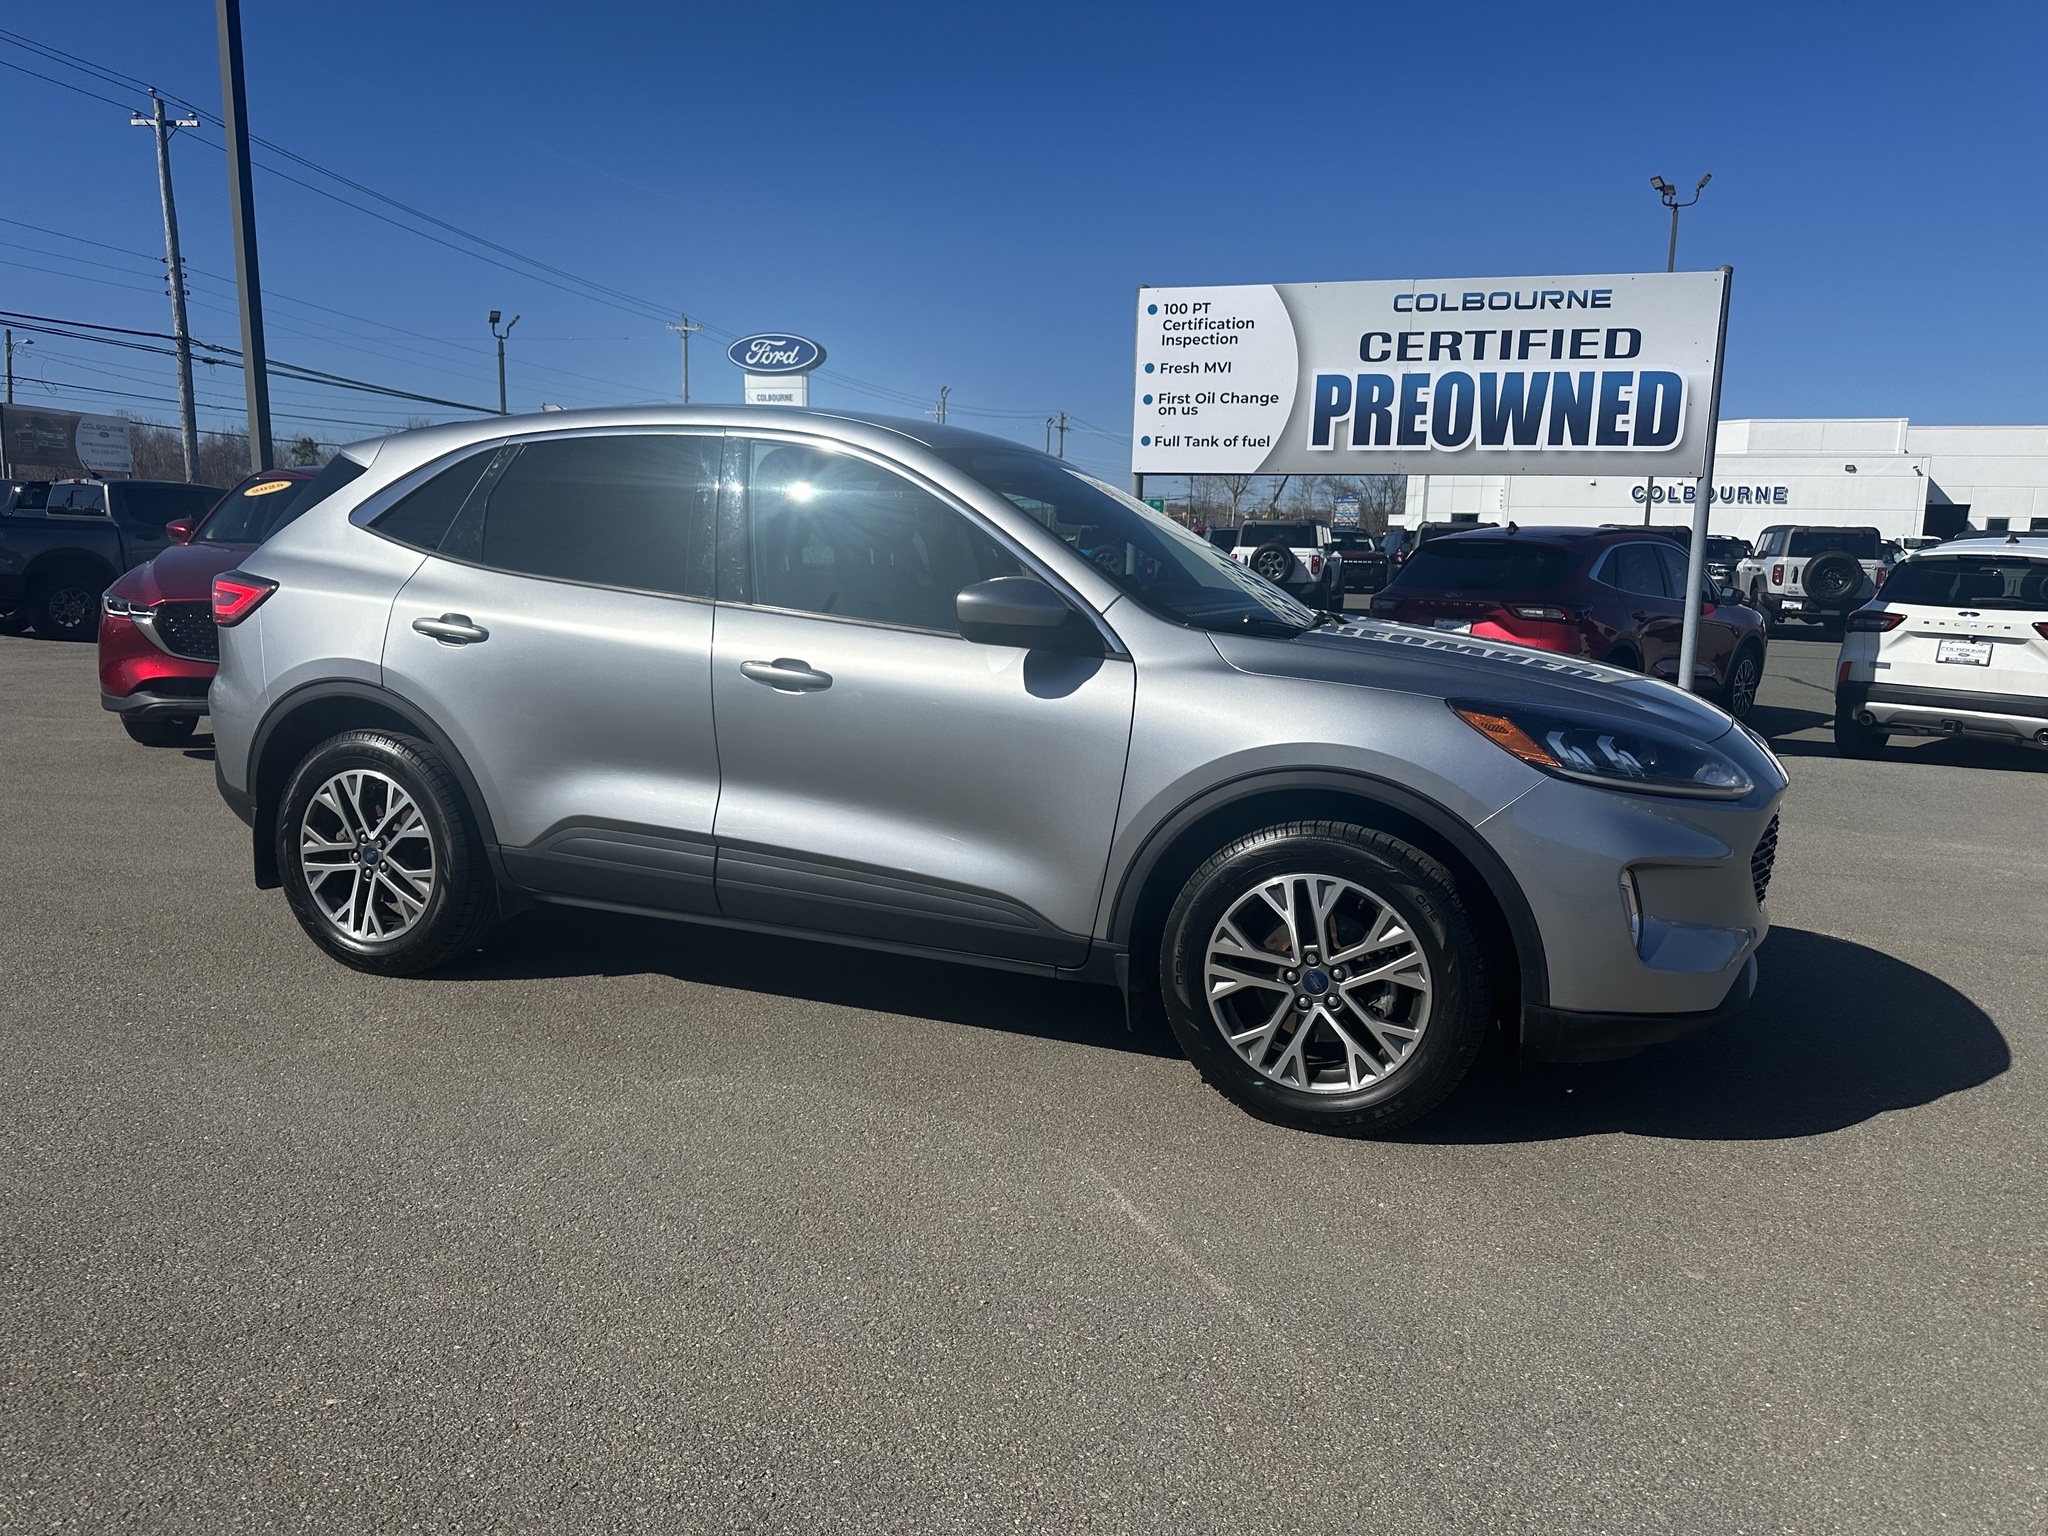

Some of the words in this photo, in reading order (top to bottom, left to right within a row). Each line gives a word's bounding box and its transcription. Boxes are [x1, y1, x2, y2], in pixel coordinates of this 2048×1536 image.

[1163, 302, 1189, 315] 100
[1192, 302, 1211, 315] PT
[1393, 289, 1613, 313] COLBOURNE
[1162, 316, 1255, 331] Certification
[1161, 332, 1239, 348] Inspection
[1359, 328, 1642, 363] CERTIFIED
[746, 339, 800, 364] Ford
[1160, 361, 1200, 374] Fresh
[1204, 361, 1232, 374] MVI
[756, 393, 794, 403] COLBOURNE
[1158, 391, 1191, 404] First
[1195, 391, 1216, 404] Oil
[1219, 391, 1280, 407] Change
[1158, 406, 1176, 416] on
[1181, 406, 1199, 416] us
[1311, 370, 1684, 448] PREOWNED
[82, 422, 124, 433] COLBOURNE
[1154, 435, 1180, 447] Full
[1184, 435, 1219, 447] Tank
[1223, 435, 1239, 447] of
[1242, 435, 1270, 447] fuel
[1631, 485, 1787, 504] COLBURNE
